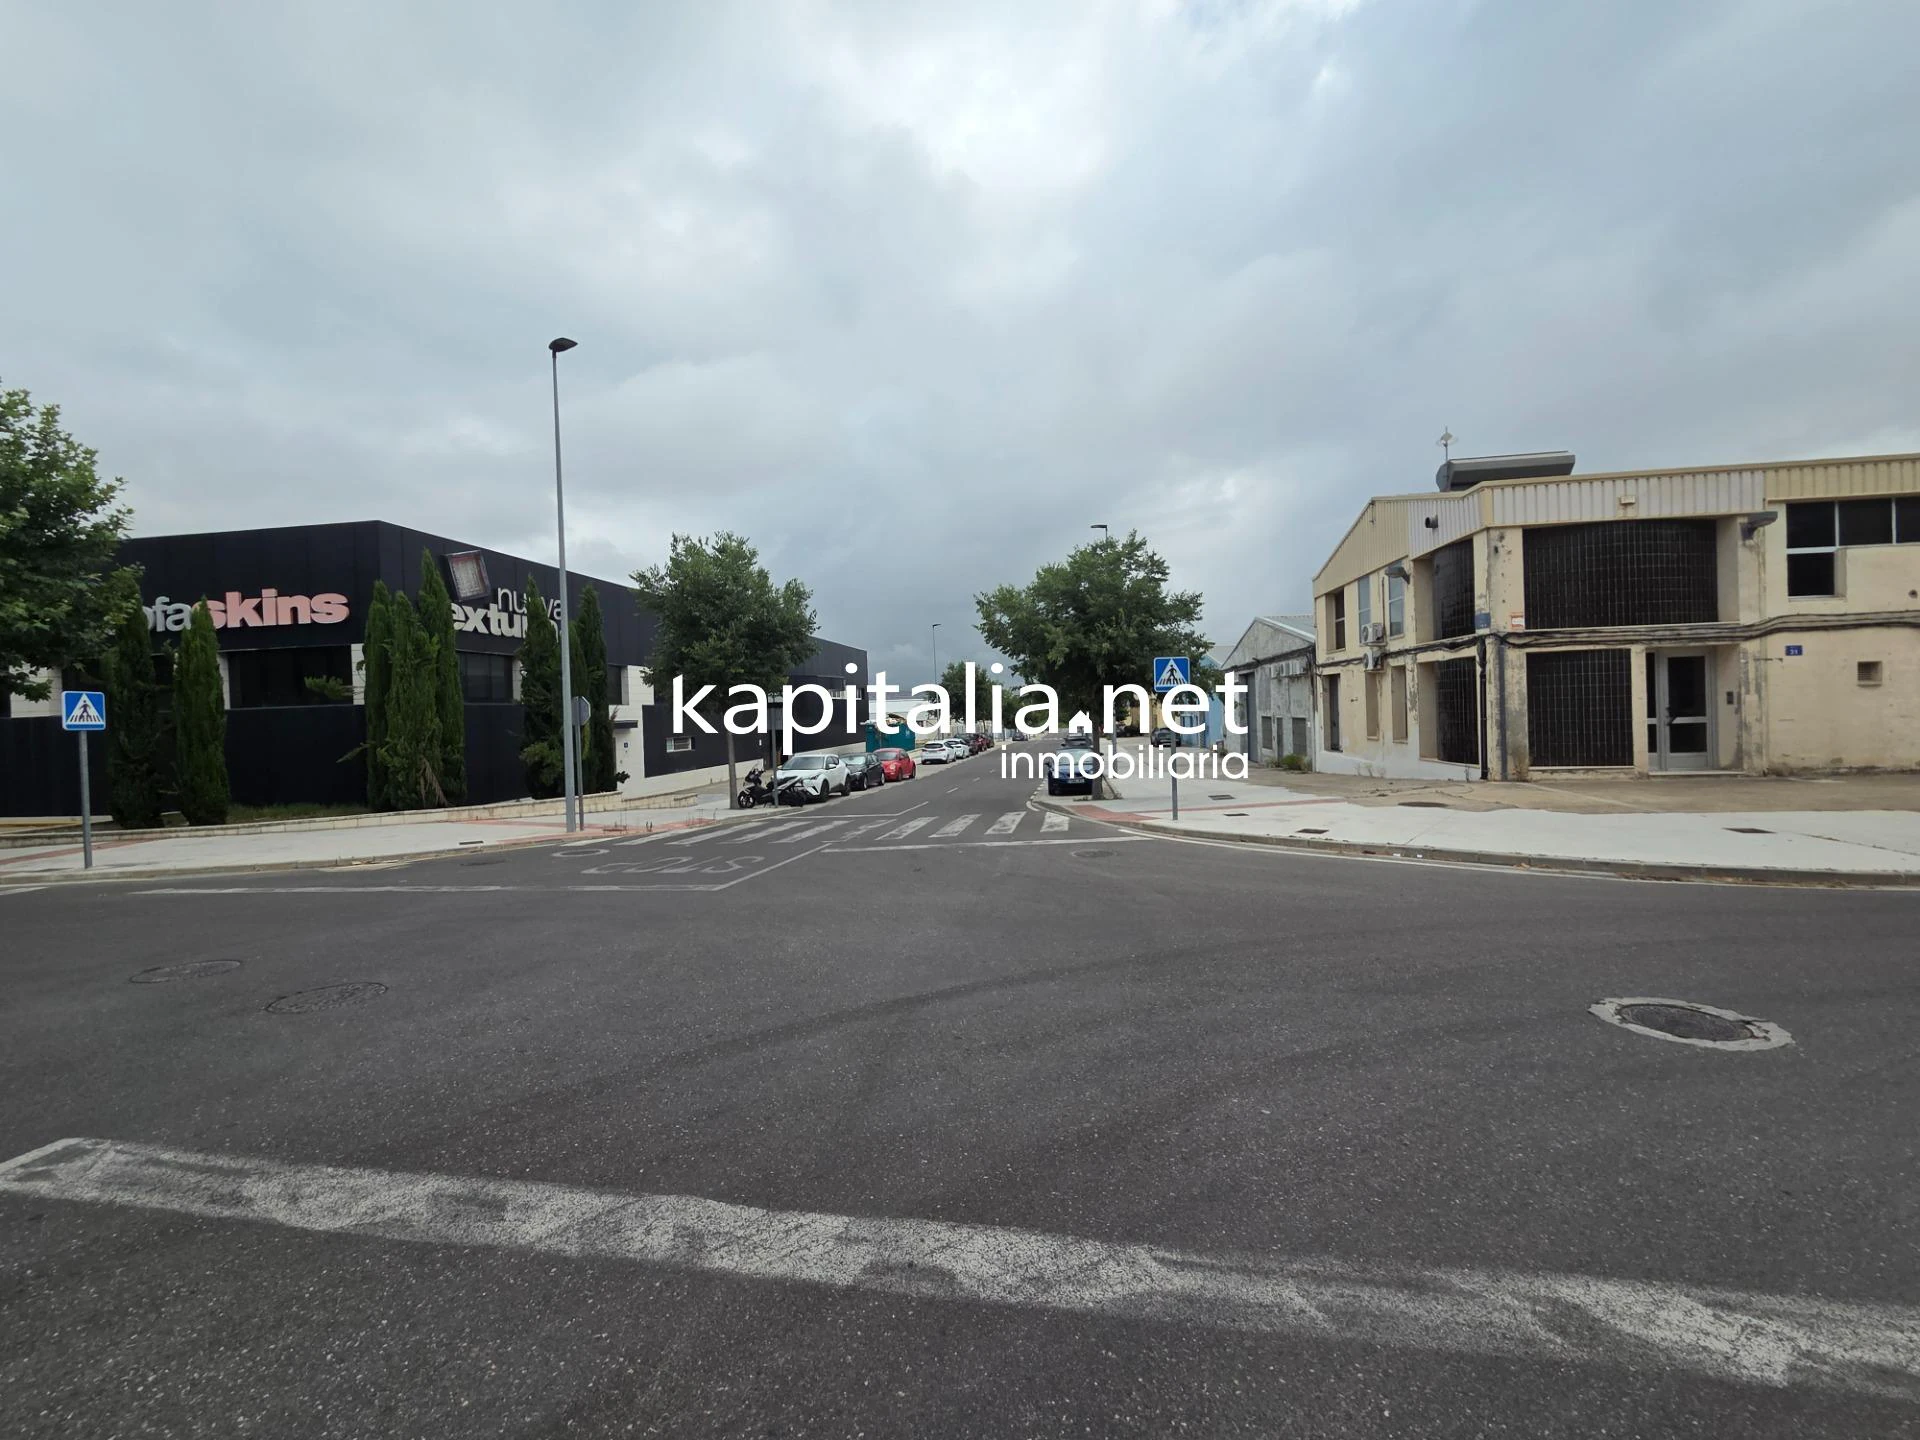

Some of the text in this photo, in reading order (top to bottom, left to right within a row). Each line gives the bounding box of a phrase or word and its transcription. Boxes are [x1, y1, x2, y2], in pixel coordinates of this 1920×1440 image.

[142, 588, 350, 632] faskins
[450, 602, 559, 643] extu
[497, 587, 562, 620] nuva
